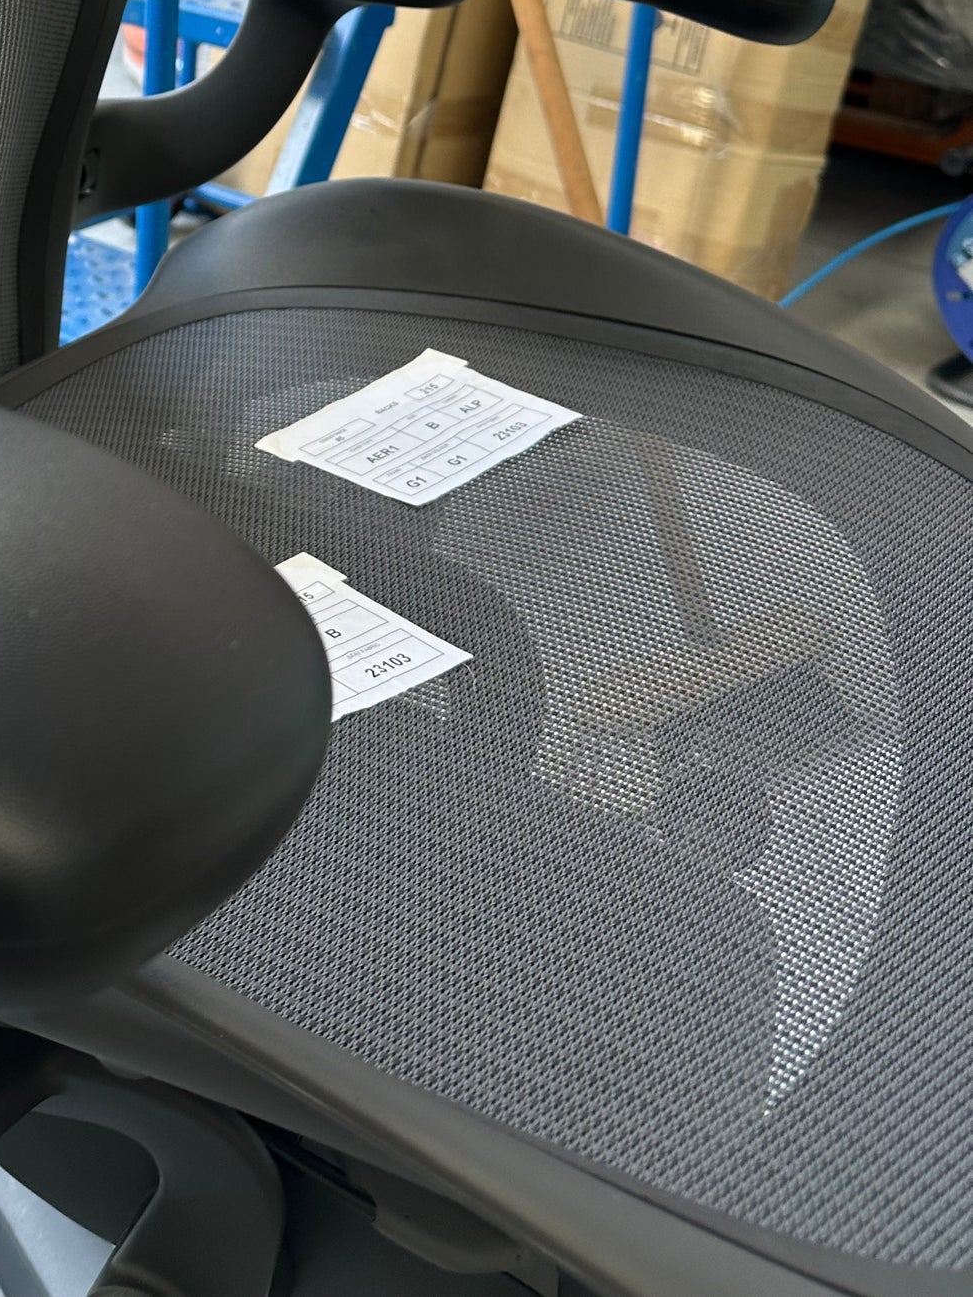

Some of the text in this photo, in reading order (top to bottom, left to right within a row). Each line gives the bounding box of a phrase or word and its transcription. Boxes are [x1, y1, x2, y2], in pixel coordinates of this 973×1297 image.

[365, 445, 400, 464] AER1
[425, 421, 440, 430] B
[459, 399, 481, 414] ALP
[406, 475, 427, 489] G1
[446, 454, 468, 467] G1
[492, 421, 528, 441] 23103
[299, 591, 315, 602] 15
[325, 628, 342, 639] B
[364, 653, 412, 678] 23103
